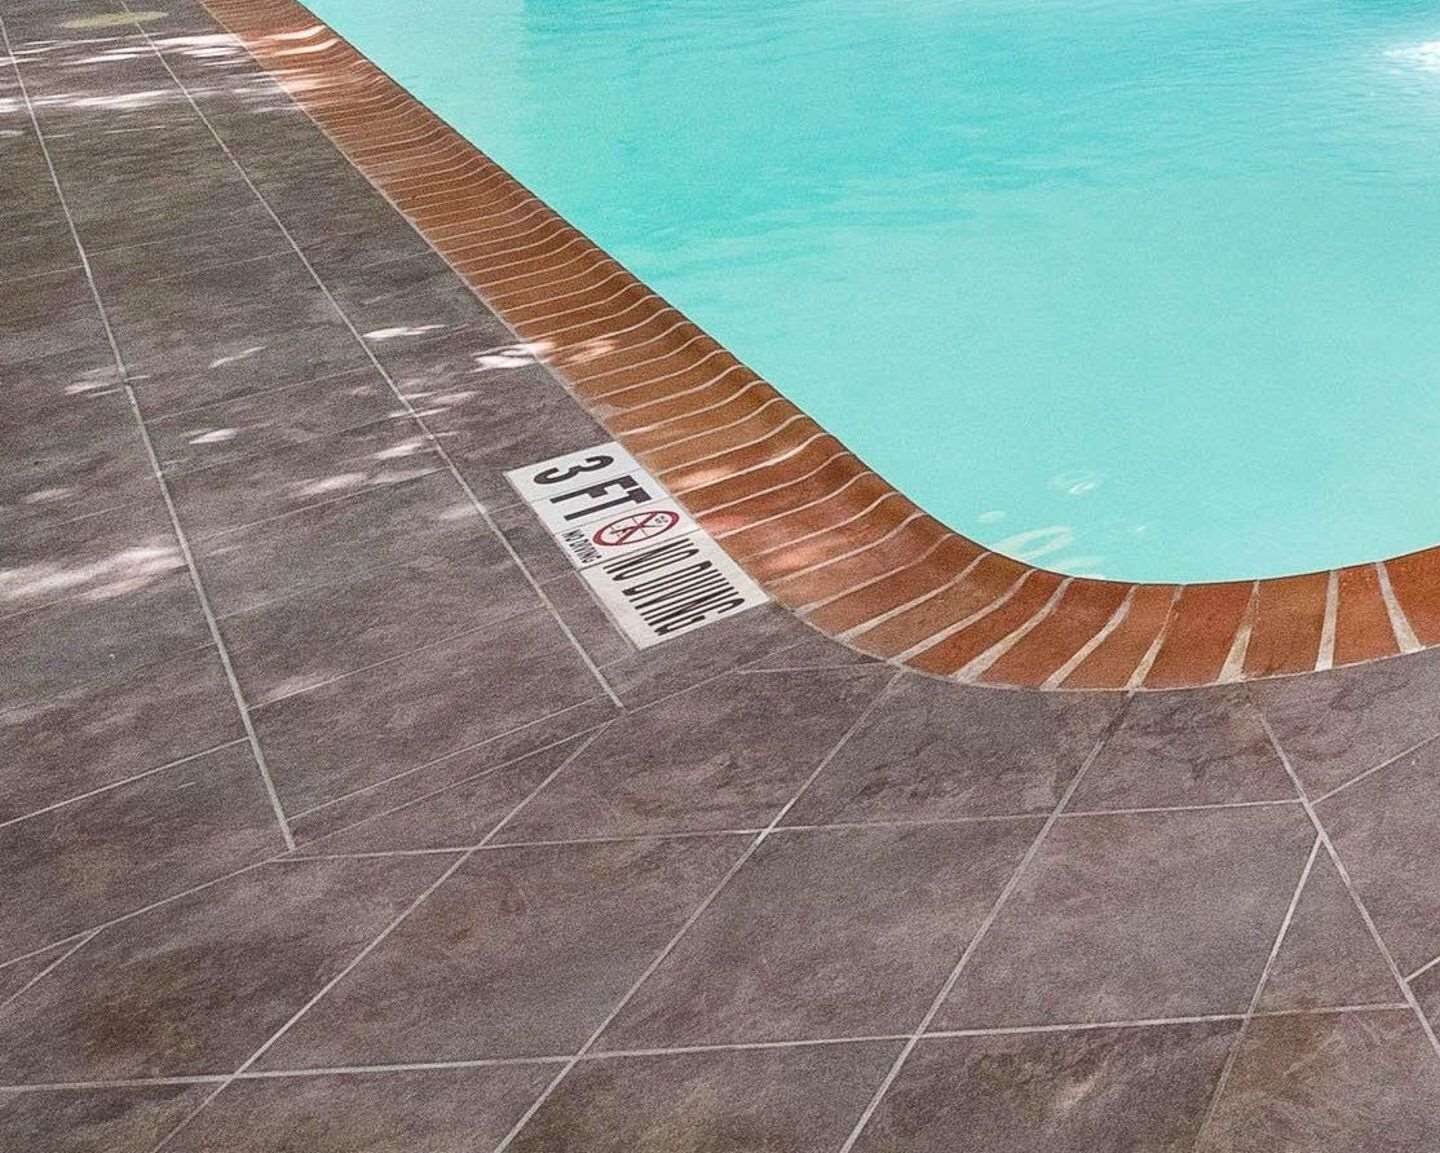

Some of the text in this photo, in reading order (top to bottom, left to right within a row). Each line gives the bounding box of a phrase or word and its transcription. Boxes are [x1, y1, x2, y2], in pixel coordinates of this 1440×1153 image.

[534, 455, 652, 521] 3 FT
[602, 538, 745, 636] NO DIVING
